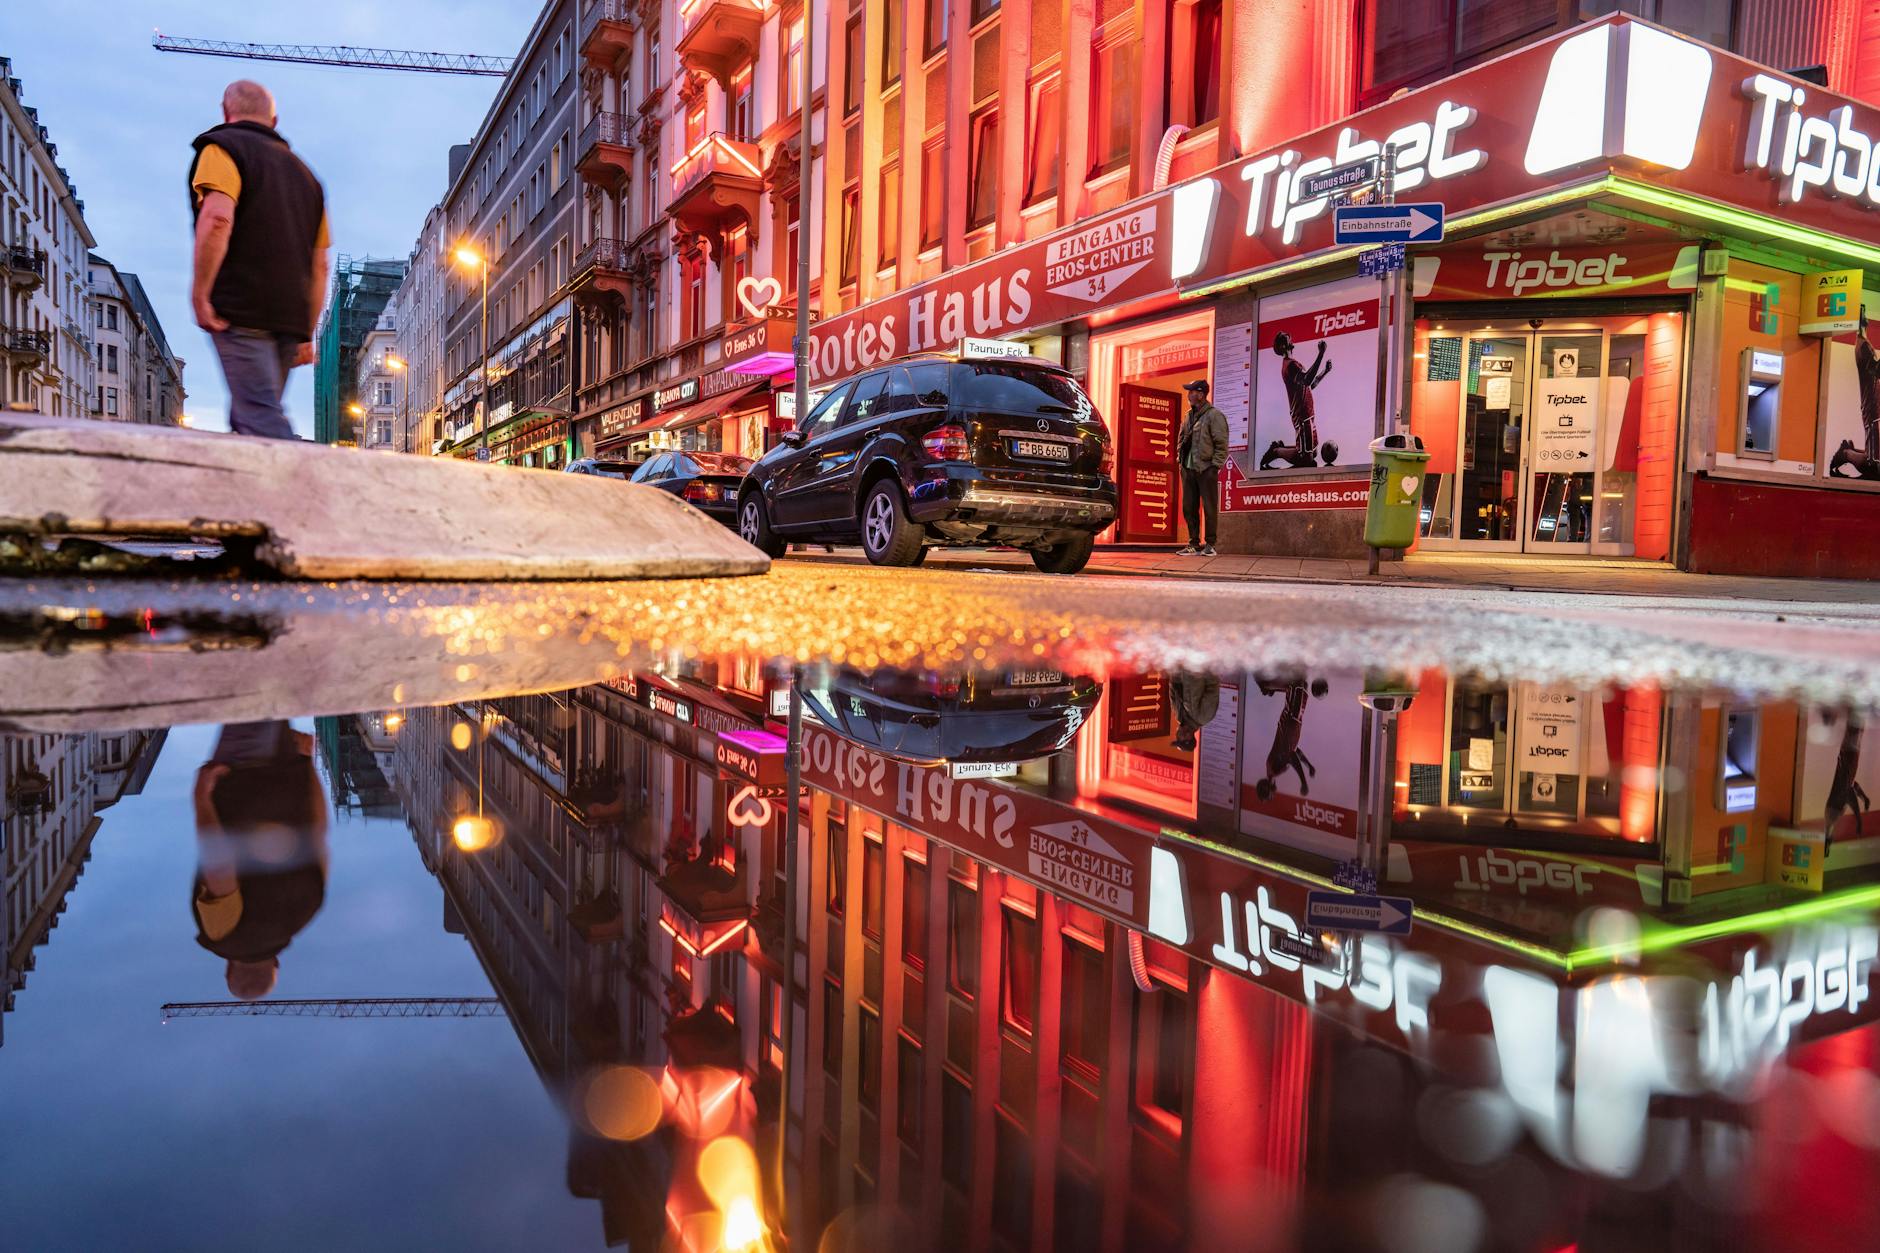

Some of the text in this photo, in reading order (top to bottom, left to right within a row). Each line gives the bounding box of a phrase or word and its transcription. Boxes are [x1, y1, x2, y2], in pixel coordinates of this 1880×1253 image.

[1341, 219, 1412, 231] Einbahnstraße
[1058, 216, 1142, 260] EINGANG
[1046, 236, 1154, 286] EROS-CENTER
[1482, 250, 1633, 297] Tipbet
[1818, 275, 1848, 286] ATM
[1088, 275, 1106, 297] 34
[907, 268, 1032, 353] Haus
[1313, 308, 1366, 337] Tipbet
[733, 333, 756, 354] Eros 36
[967, 342, 1024, 357] Taunus Eck
[681, 381, 695, 399] CITY
[1546, 394, 1588, 407] Tipbet
[601, 403, 641, 427] VALENTINO
[1019, 443, 1069, 458] F BB 6650
[1225, 459, 1233, 511] GIRLS
